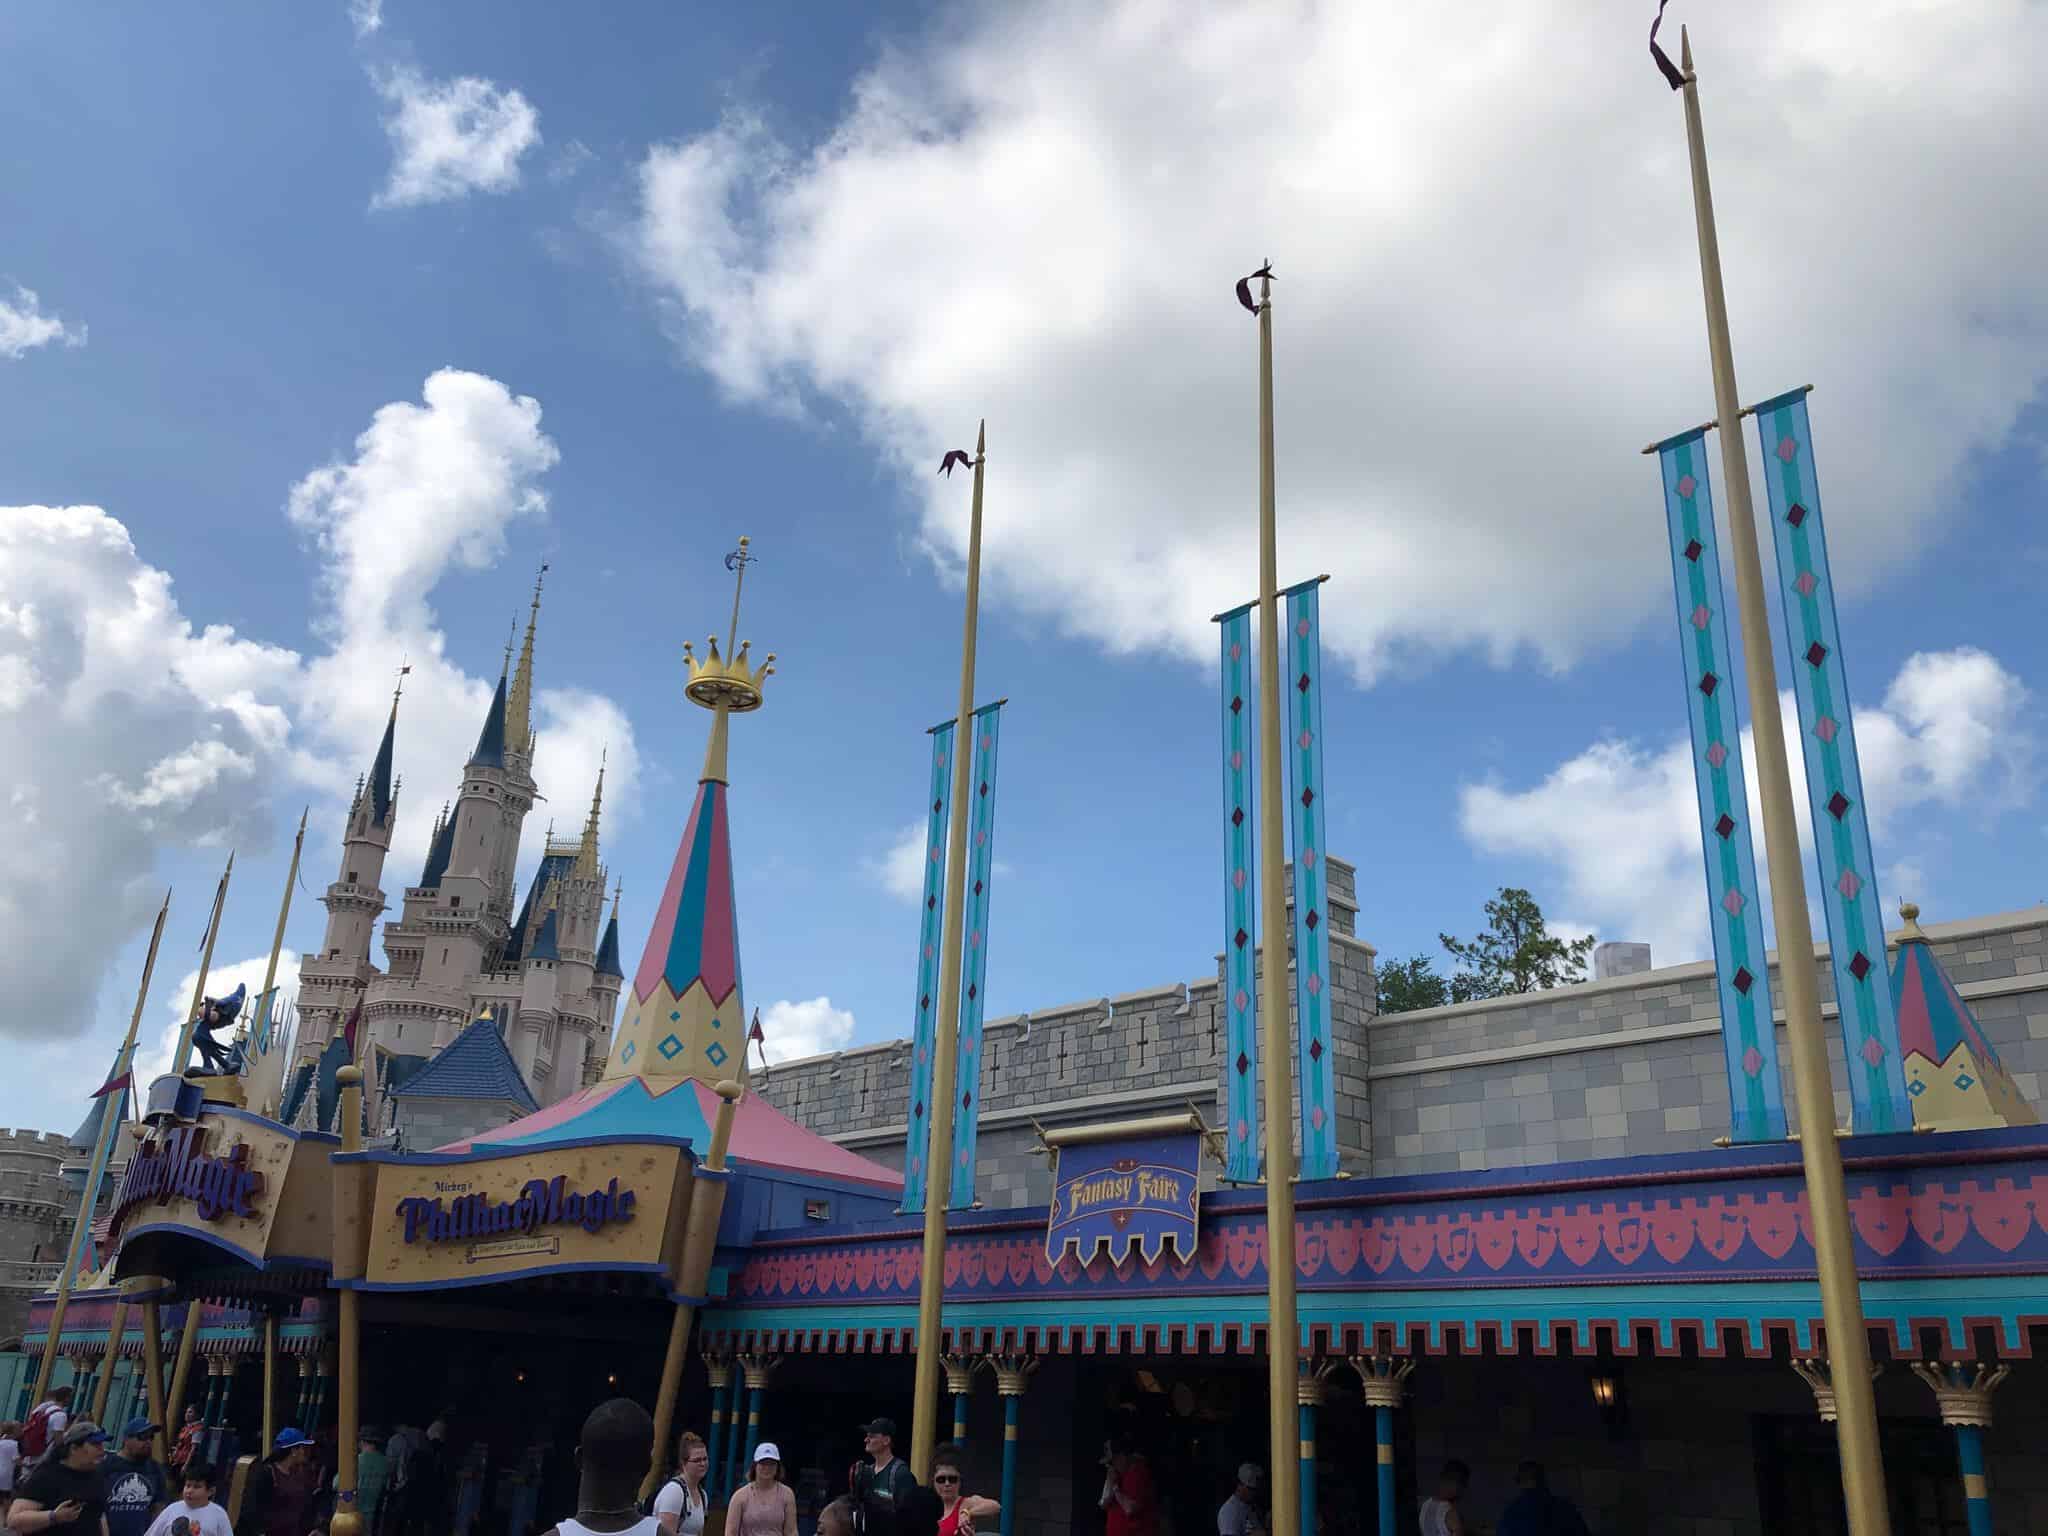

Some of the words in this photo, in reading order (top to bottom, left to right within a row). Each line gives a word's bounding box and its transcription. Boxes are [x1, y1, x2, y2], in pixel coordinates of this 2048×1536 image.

[396, 1175, 637, 1243] PhilharMagic
[1069, 1176, 1132, 1217] Fantasy
[1137, 1171, 1179, 1206] Faire
